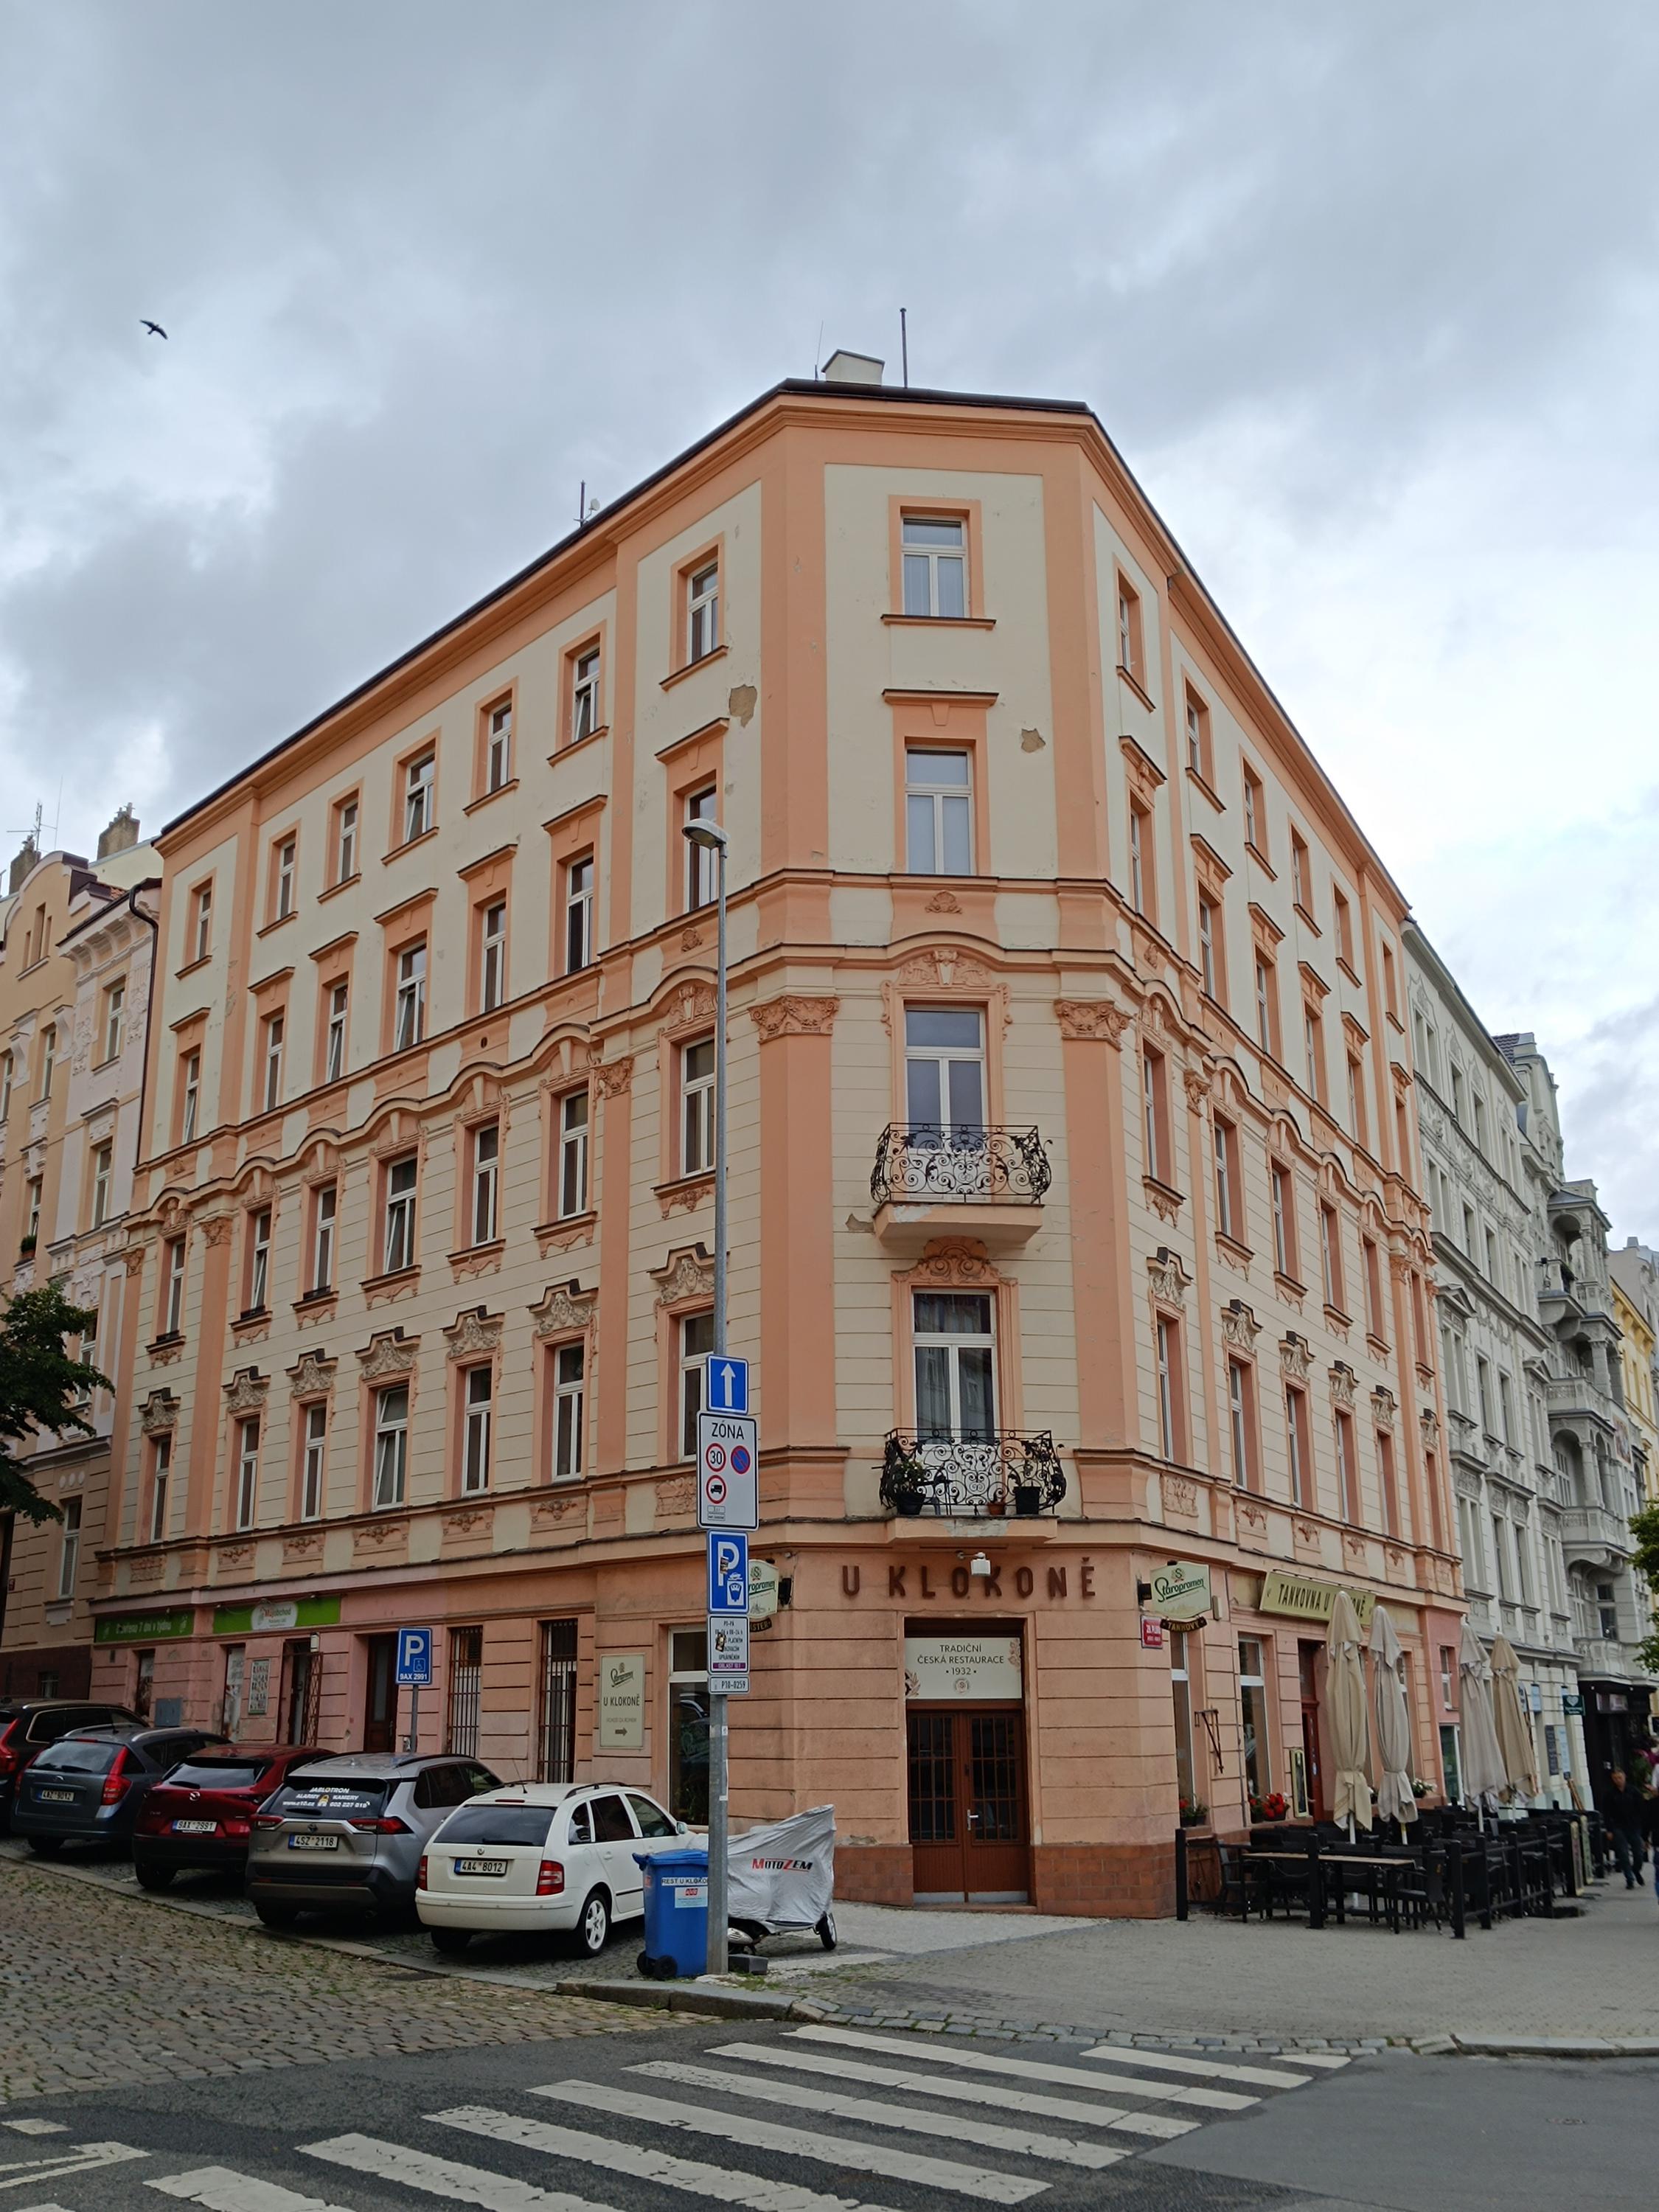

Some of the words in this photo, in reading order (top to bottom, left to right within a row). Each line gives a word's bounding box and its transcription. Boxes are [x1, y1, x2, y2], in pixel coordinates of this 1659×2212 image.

[712, 1420, 744, 1439] ZÓNA
[710, 1450, 722, 1464] 30
[718, 1541, 740, 1587] P
[843, 1565, 860, 1596] U
[888, 1557, 1096, 1599] KLOKONĚ
[1155, 1577, 1207, 1603] Staropramen
[1278, 1583, 1321, 1611] TANKOVNA
[1324, 1593, 1331, 1612] U
[405, 1635, 424, 1666] P
[939, 1643, 982, 1653] TRADIČNÍ
[917, 1654, 947, 1664] ČESKÁ
[949, 1655, 1004, 1664] RESTAURACE
[951, 1666, 971, 1676] 1932
[721, 1680, 746, 1688] P10-0259
[604, 1697, 608, 1706] U
[611, 1693, 640, 1706] KLOKONĚ
[462, 1861, 477, 1871] 4A4
[481, 1862, 503, 1872] 8012
